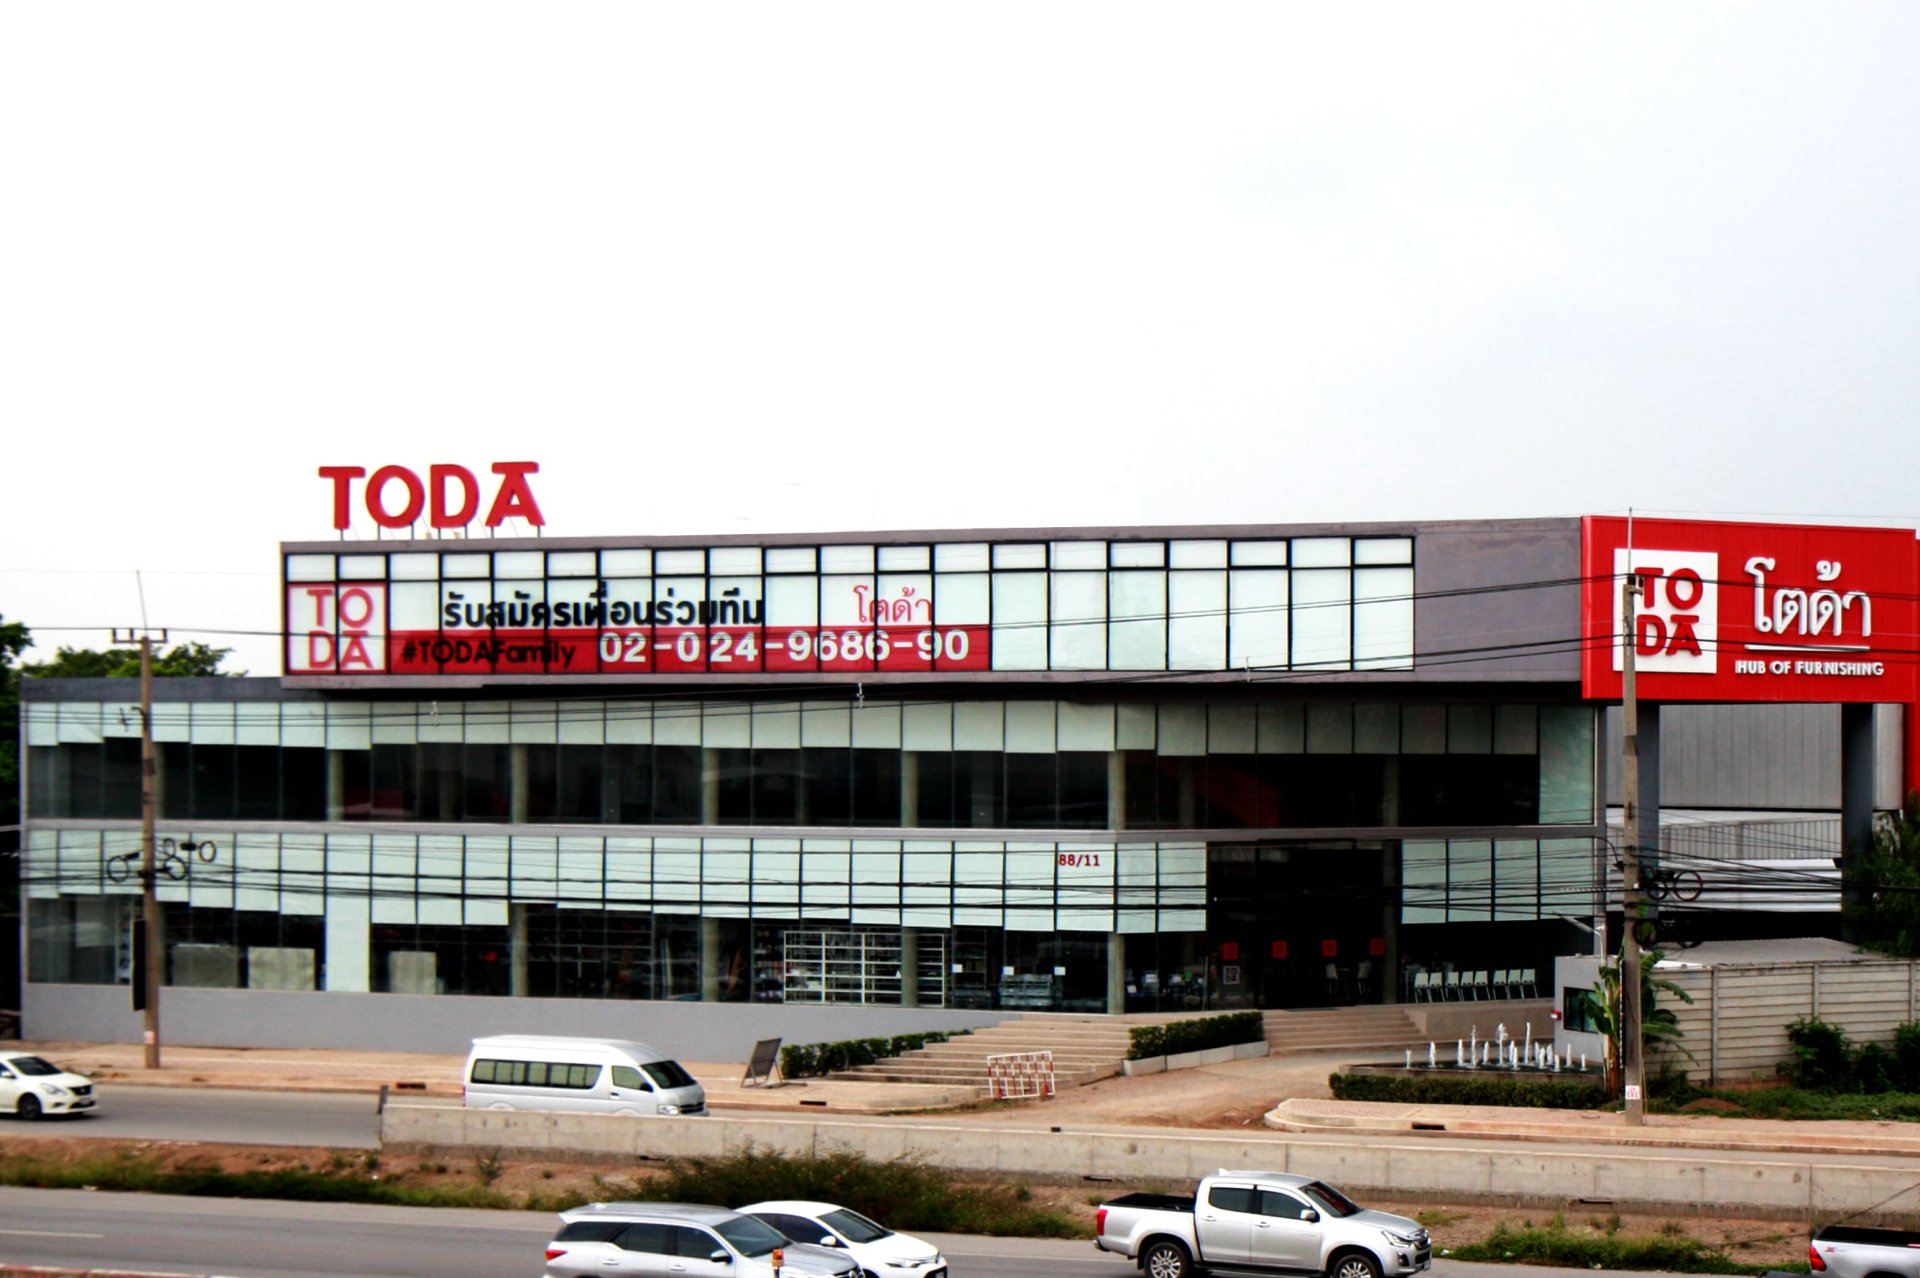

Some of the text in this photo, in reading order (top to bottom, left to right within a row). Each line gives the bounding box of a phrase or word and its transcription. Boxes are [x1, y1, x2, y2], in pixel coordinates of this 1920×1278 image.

[318, 461, 546, 530] TODA
[306, 588, 374, 628] TO
[1634, 567, 1704, 610] TO
[1744, 557, 1872, 636] โตด้า
[1636, 614, 1702, 656] DA
[1735, 660, 1885, 676] HUB OF FURNISHING
[1059, 854, 1100, 867] 88/11
